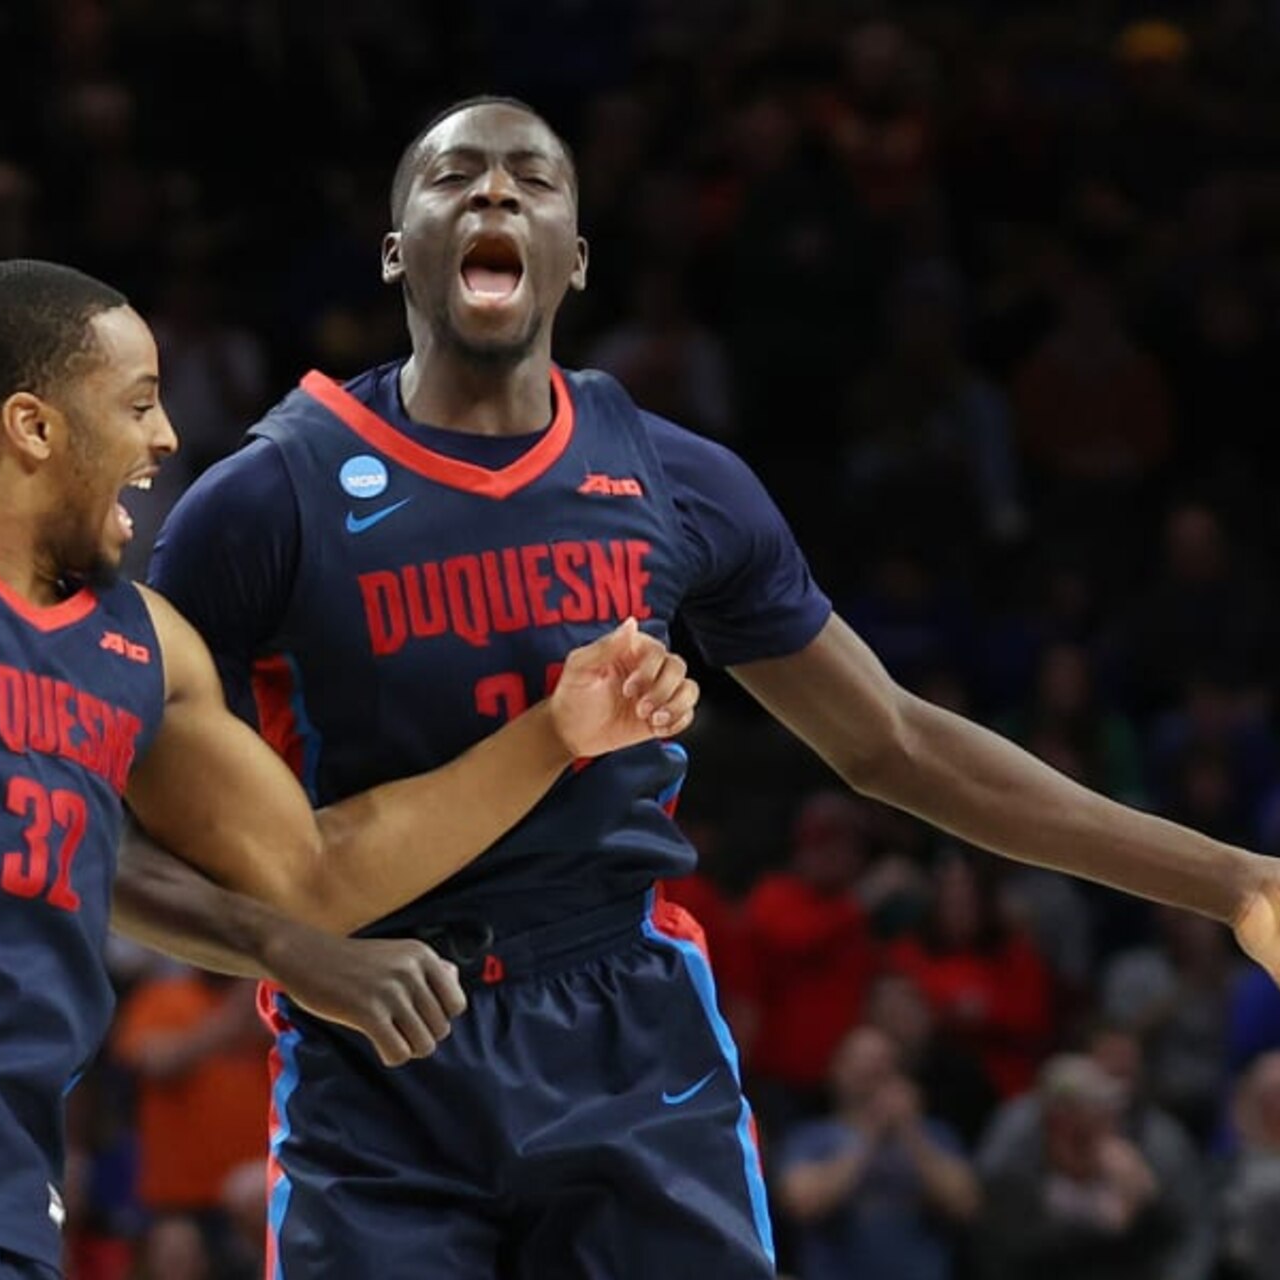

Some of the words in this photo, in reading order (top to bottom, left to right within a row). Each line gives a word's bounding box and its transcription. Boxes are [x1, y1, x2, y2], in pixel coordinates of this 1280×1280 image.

[576, 473, 642, 497] A10
[357, 539, 652, 656] DUQUESNE
[0, 775, 88, 913] 32
